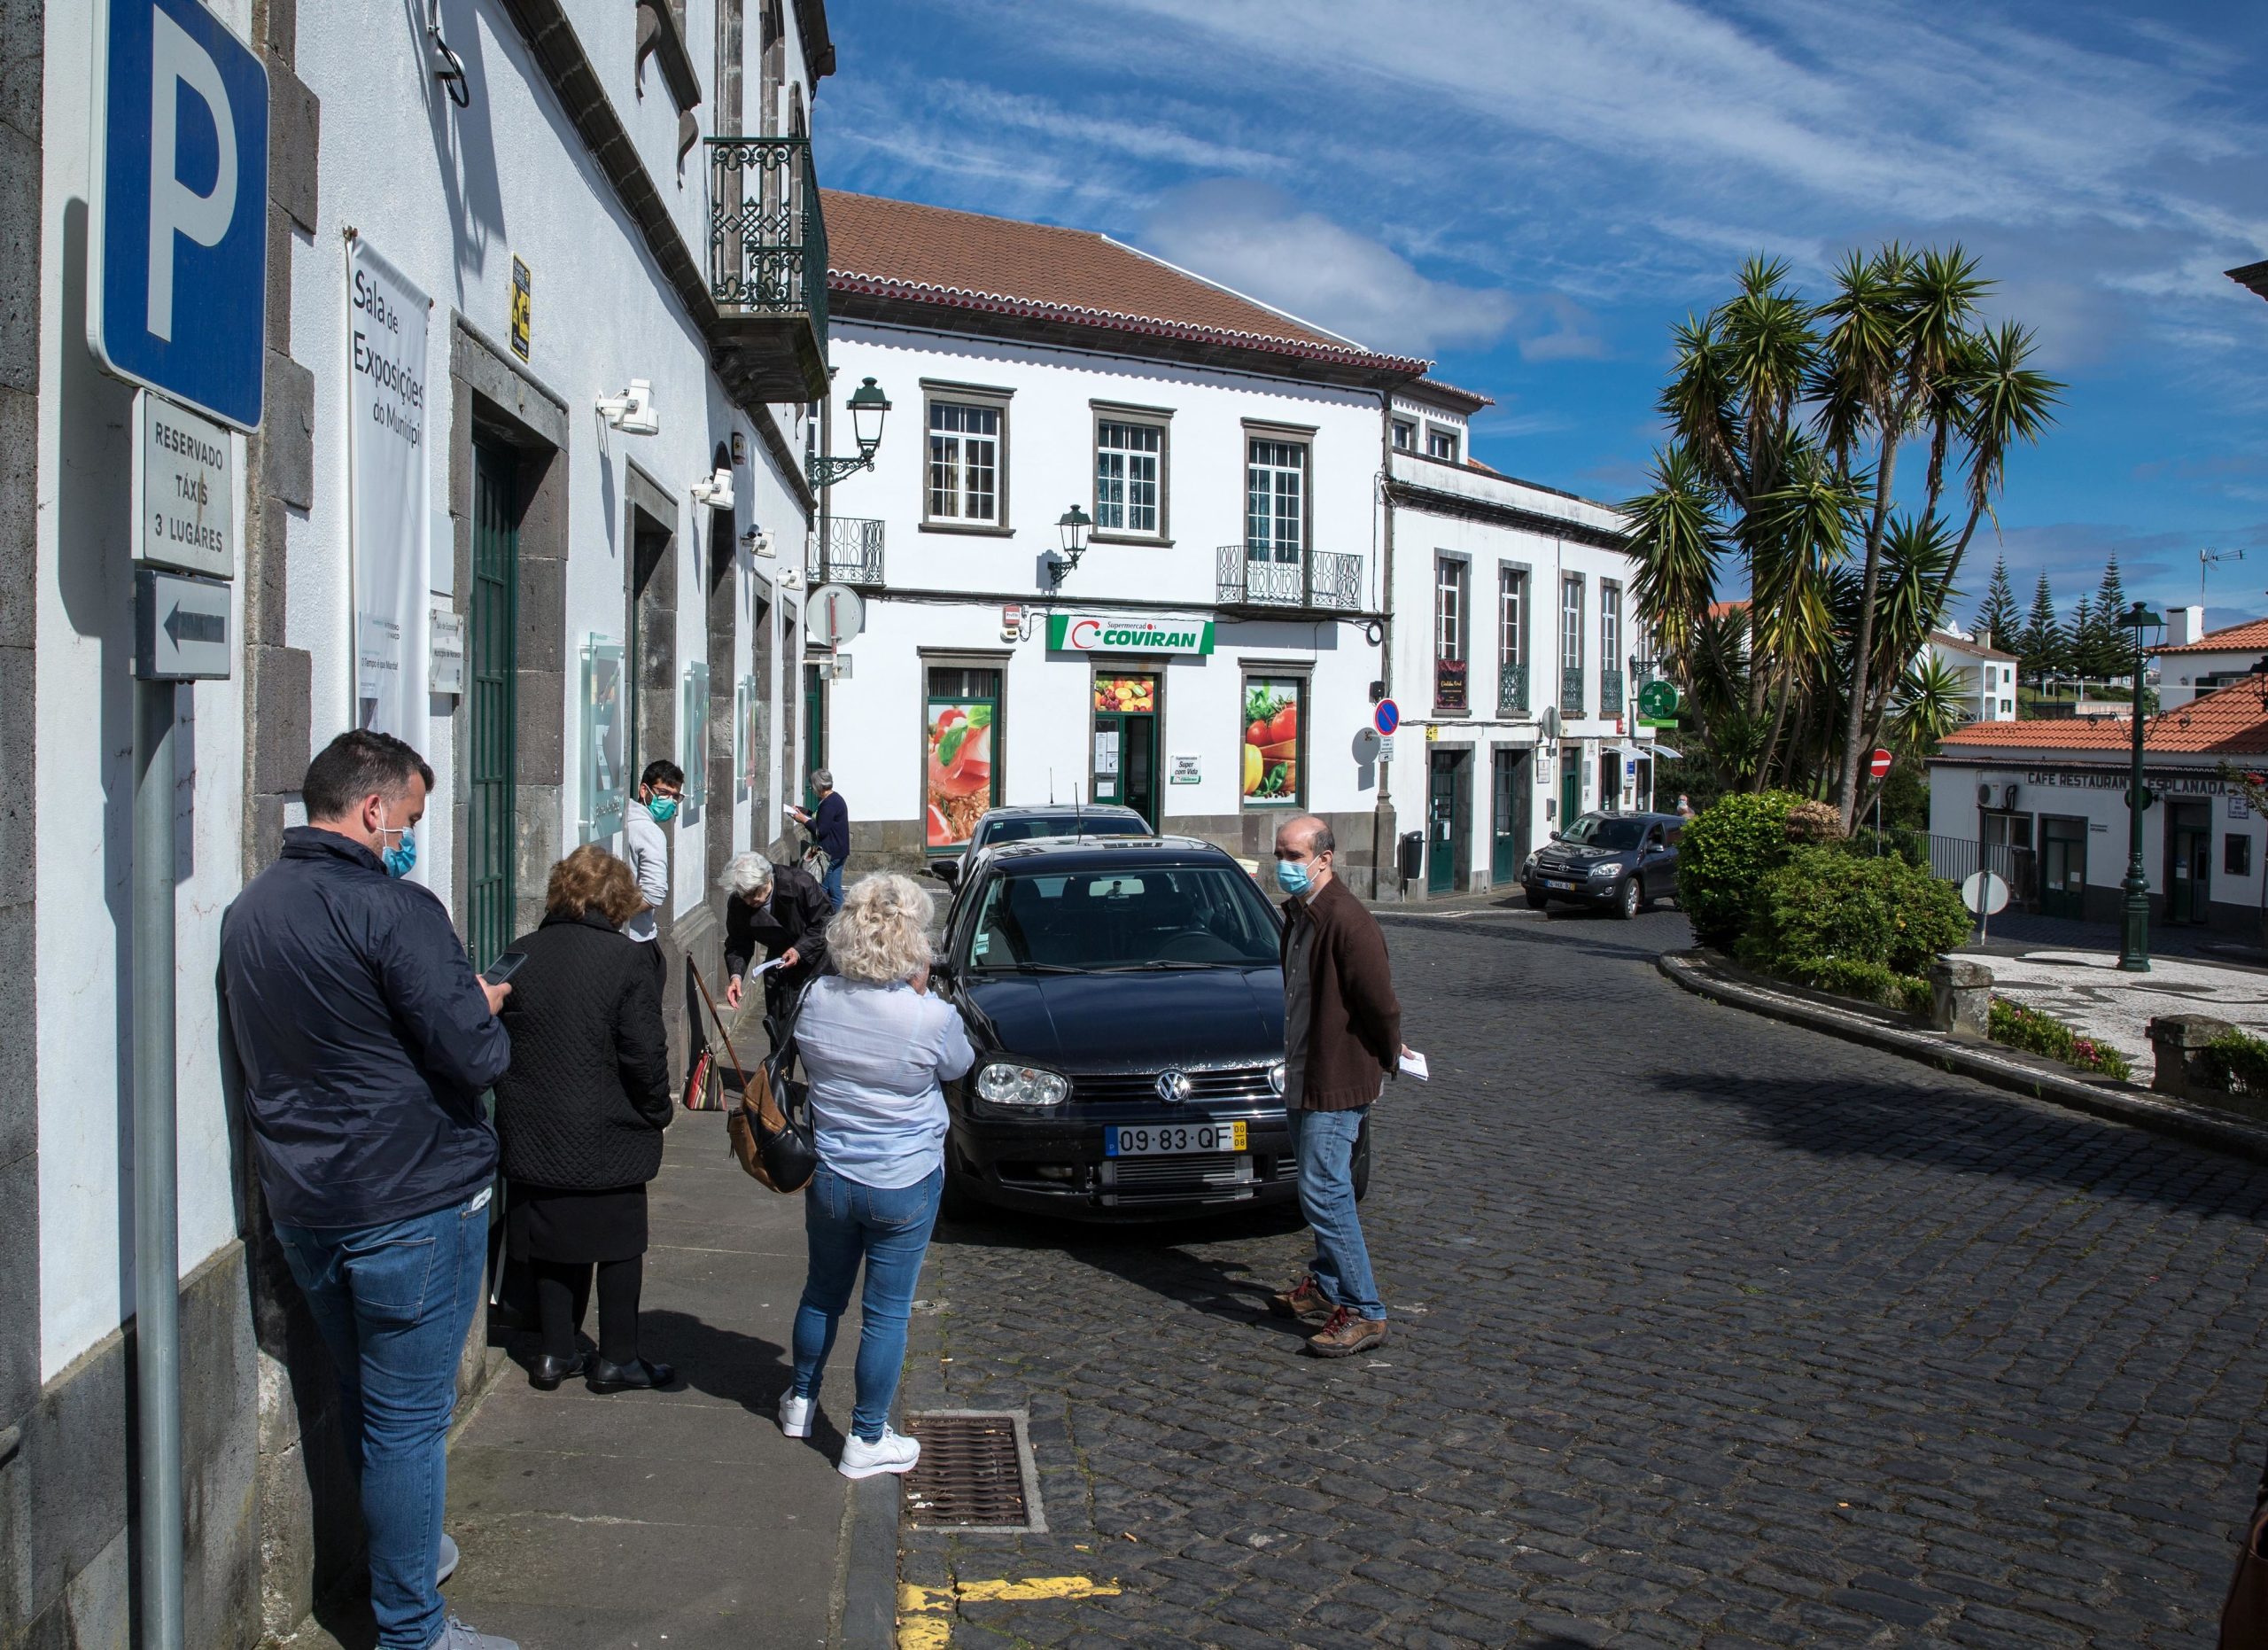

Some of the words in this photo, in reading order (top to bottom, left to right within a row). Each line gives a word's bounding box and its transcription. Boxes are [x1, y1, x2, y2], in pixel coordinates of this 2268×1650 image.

[147, 4, 237, 343] P
[353, 269, 384, 325] Sala
[387, 307, 399, 335] de
[373, 396, 384, 425] do
[155, 421, 223, 471] RESERVADO
[175, 472, 208, 506] TÁXIS
[155, 513, 163, 536] 3
[170, 518, 223, 553] LUGARES
[1103, 629, 1197, 648] COVIRAN
[2148, 777, 2226, 796] ESPLANADA
